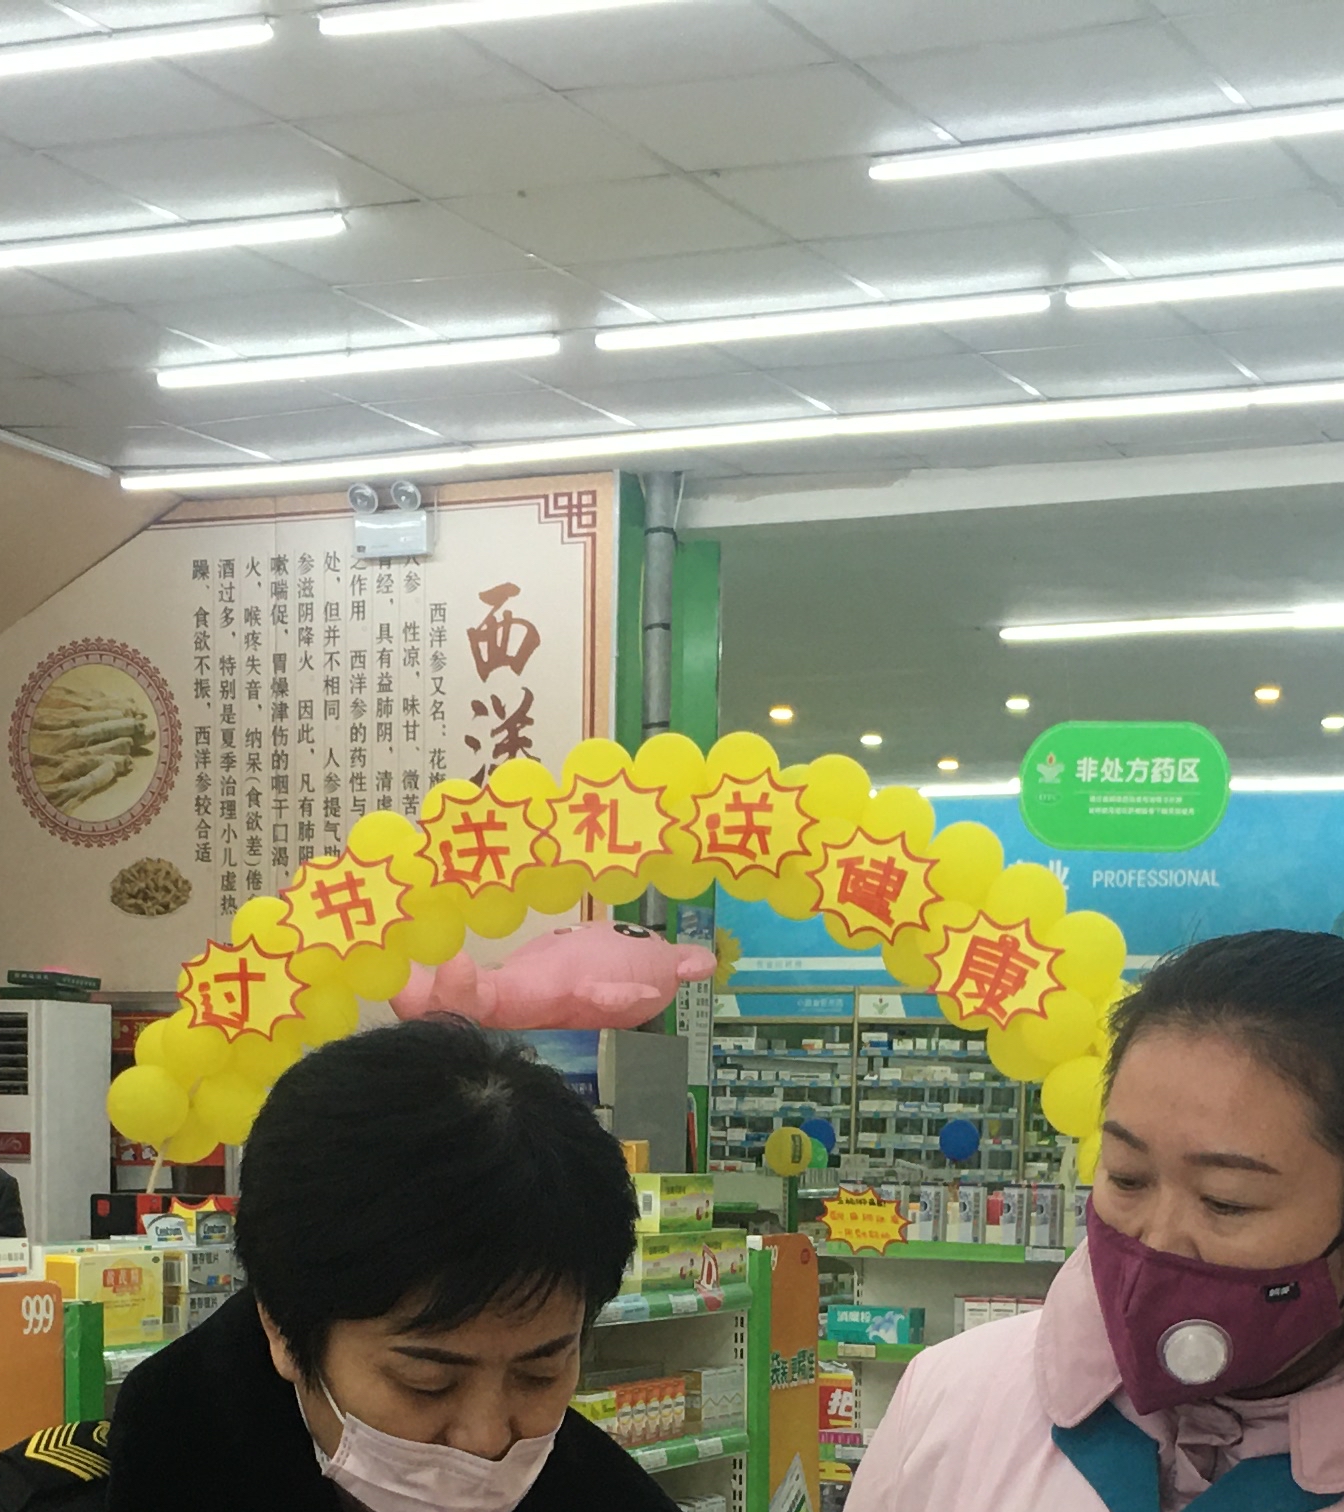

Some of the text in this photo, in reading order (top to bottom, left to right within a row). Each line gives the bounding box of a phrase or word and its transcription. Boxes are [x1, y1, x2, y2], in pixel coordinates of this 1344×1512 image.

[1075, 757, 1200, 783] 非处方药区
[1092, 867, 1220, 889] PROFESSIONAL
[21, 1294, 55, 1336] 999
